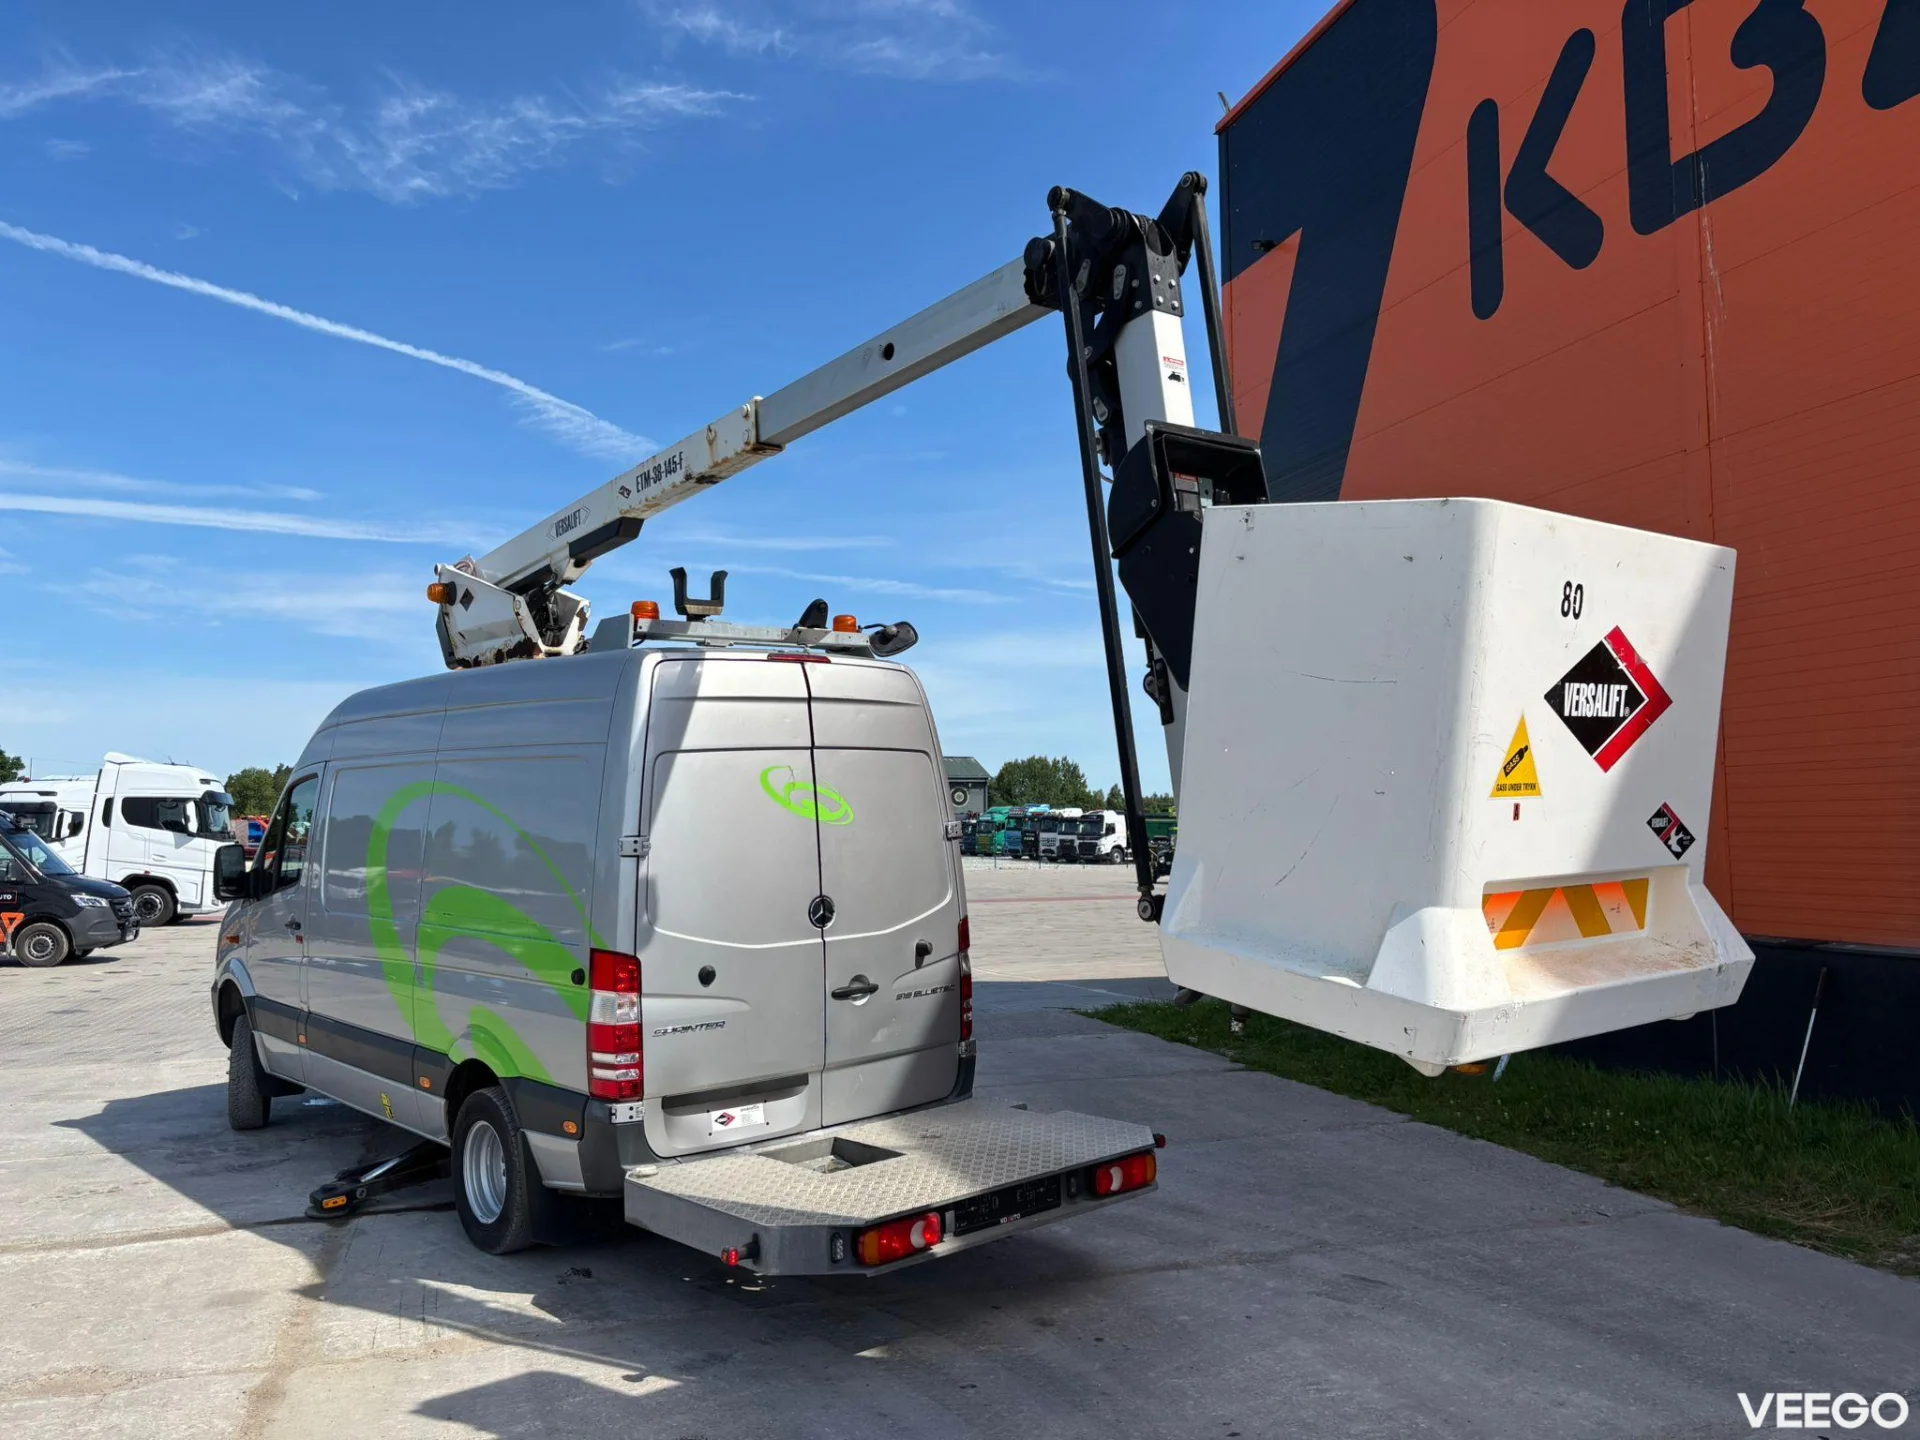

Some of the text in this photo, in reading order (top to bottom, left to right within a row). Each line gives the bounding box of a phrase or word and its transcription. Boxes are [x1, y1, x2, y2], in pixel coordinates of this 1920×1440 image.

[636, 451, 684, 493] ETM-38-145-F
[554, 508, 582, 538] VERSALIFT
[1561, 580, 1584, 620] 80
[1563, 682, 1628, 718] VERSALIFT
[1505, 754, 1521, 773] GASS
[1496, 783, 1507, 792] GASS
